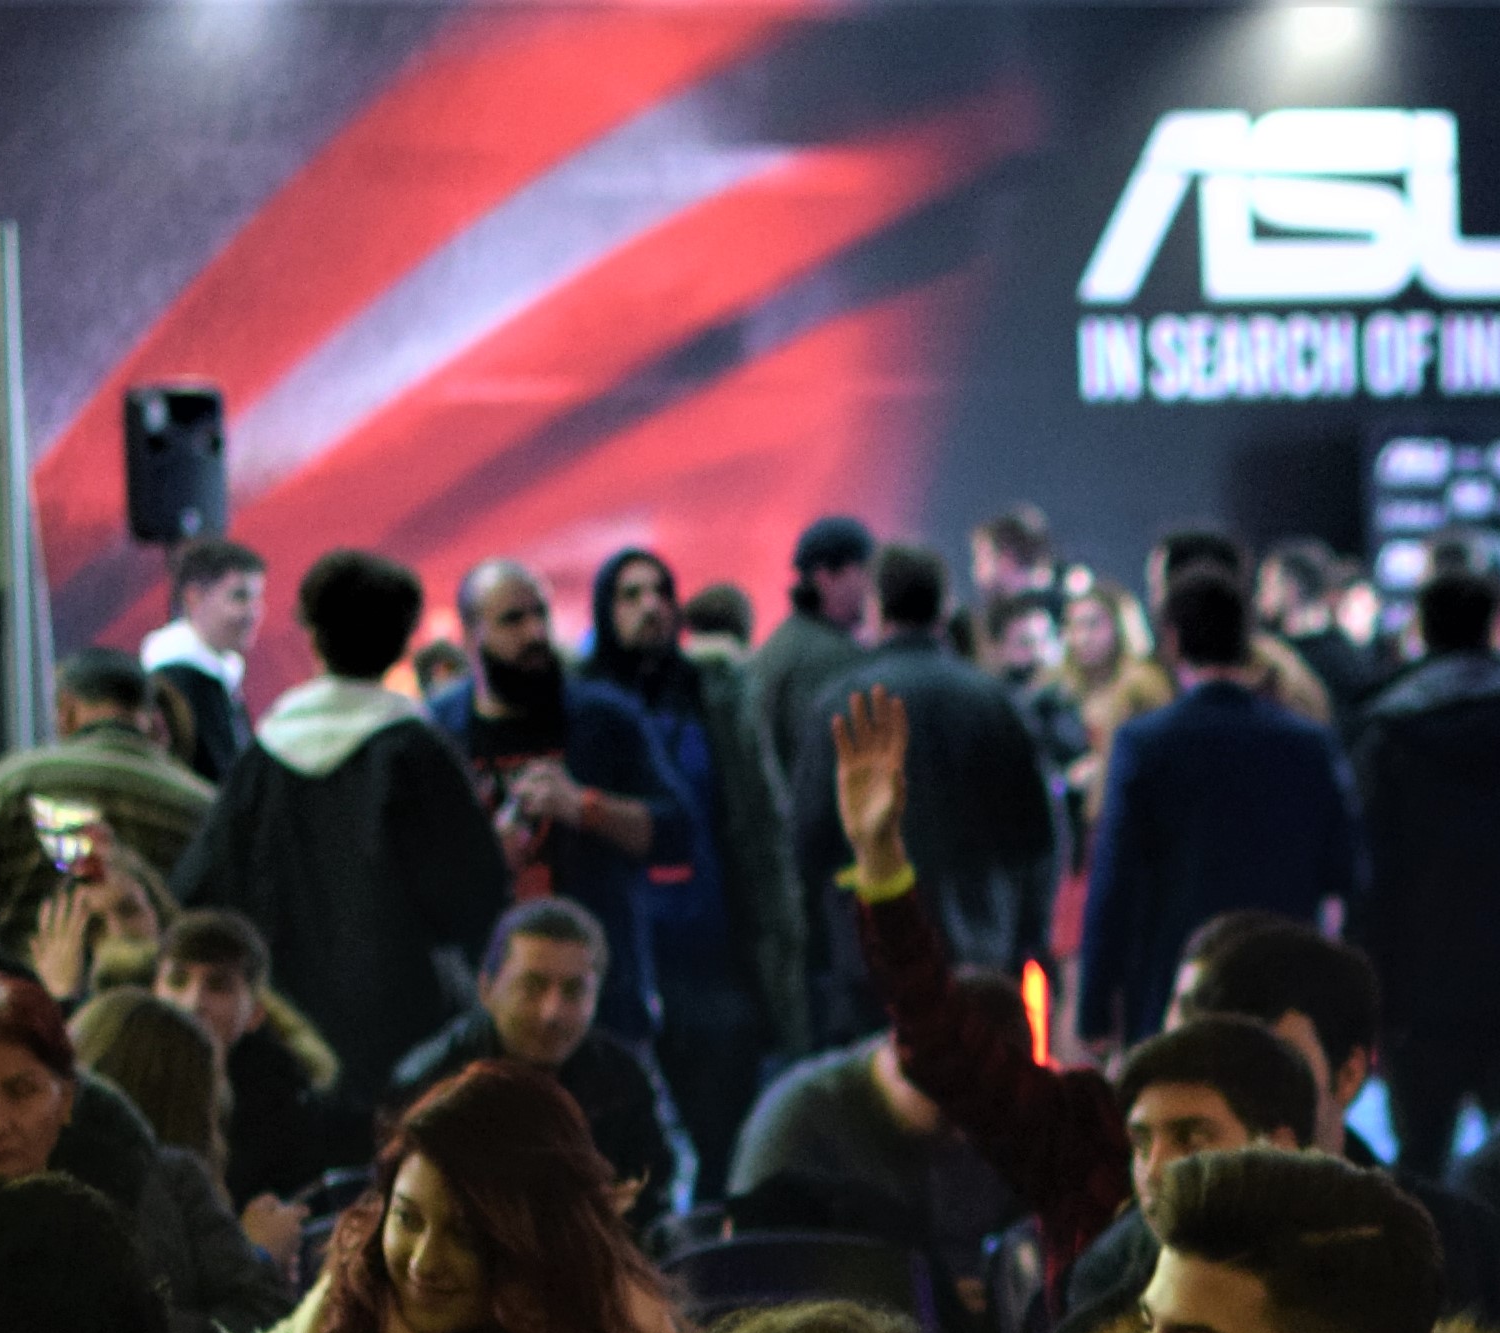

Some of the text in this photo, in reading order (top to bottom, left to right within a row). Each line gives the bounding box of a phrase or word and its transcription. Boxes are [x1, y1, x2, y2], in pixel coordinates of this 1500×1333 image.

[1079, 313, 1144, 400] IN
[1148, 311, 1358, 398] SEARCH
[1364, 309, 1434, 396] OF
